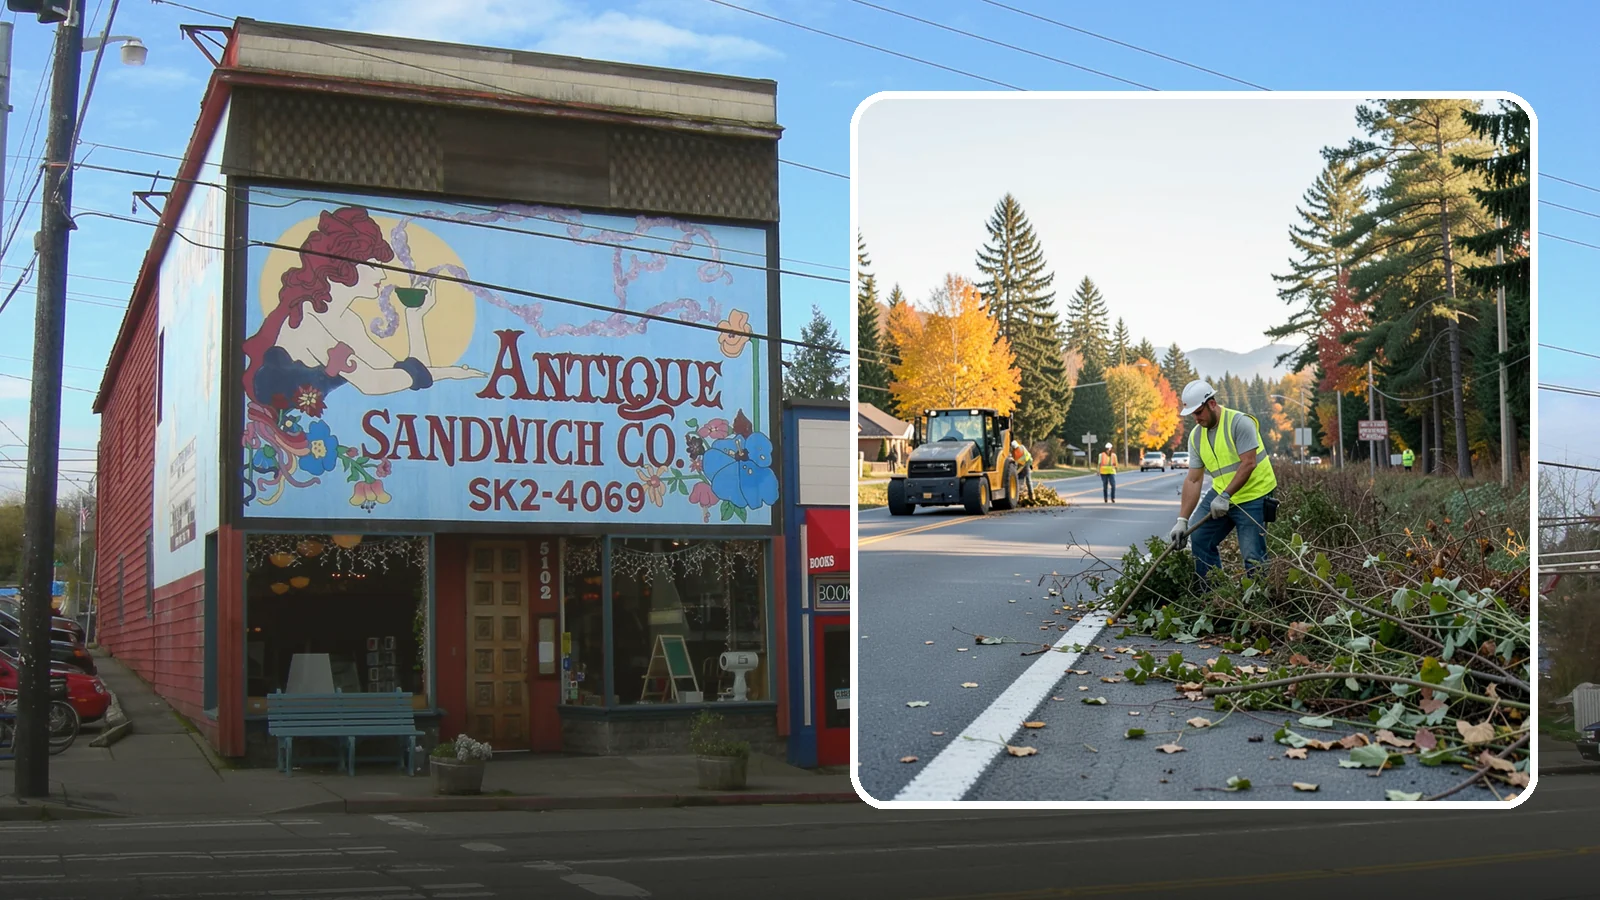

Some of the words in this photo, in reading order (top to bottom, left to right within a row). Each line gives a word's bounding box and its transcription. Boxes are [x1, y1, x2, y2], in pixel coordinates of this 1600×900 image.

[476, 330, 723, 421] ANTIQUE
[362, 409, 604, 467] SANDWICH
[617, 421, 685, 468] CO.
[468, 477, 645, 513] SK2-4069
[540, 541, 551, 600] 5102
[809, 555, 835, 569] BOOKS
